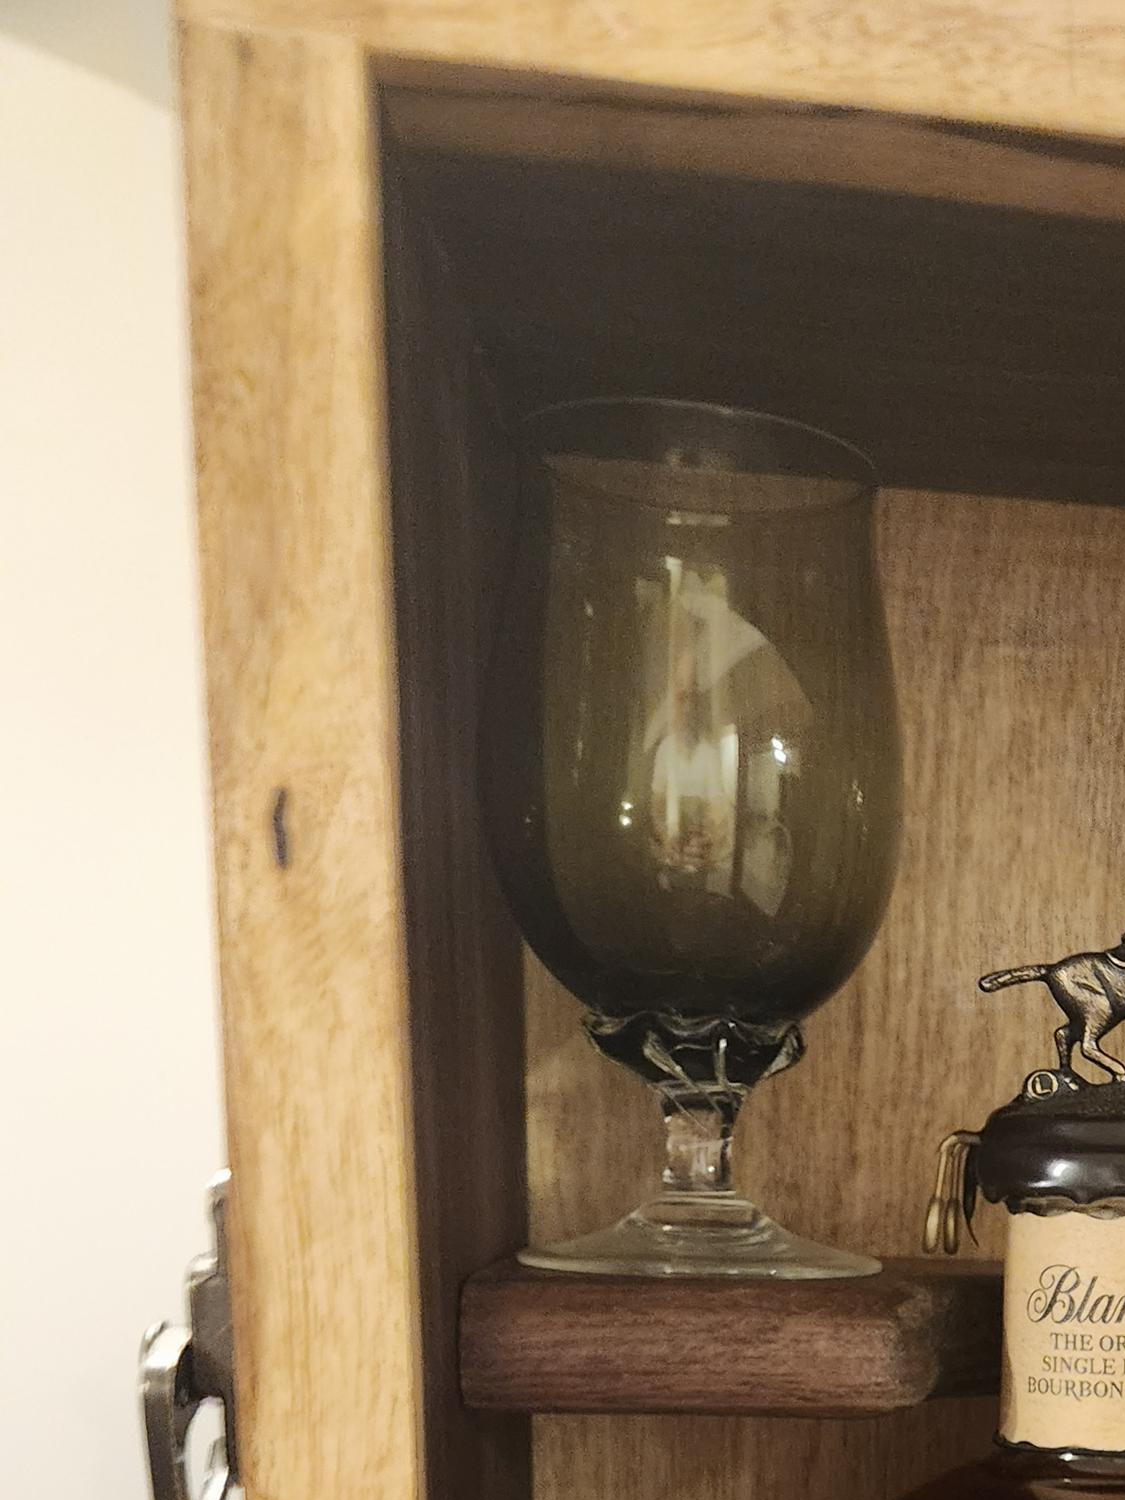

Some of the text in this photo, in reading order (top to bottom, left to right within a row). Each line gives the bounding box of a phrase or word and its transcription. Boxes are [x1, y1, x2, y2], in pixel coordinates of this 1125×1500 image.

[1051, 1332, 1093, 1352] THE
[1042, 1355, 1115, 1375] SINGLE
[1028, 1376, 1123, 1402] BOURBON
